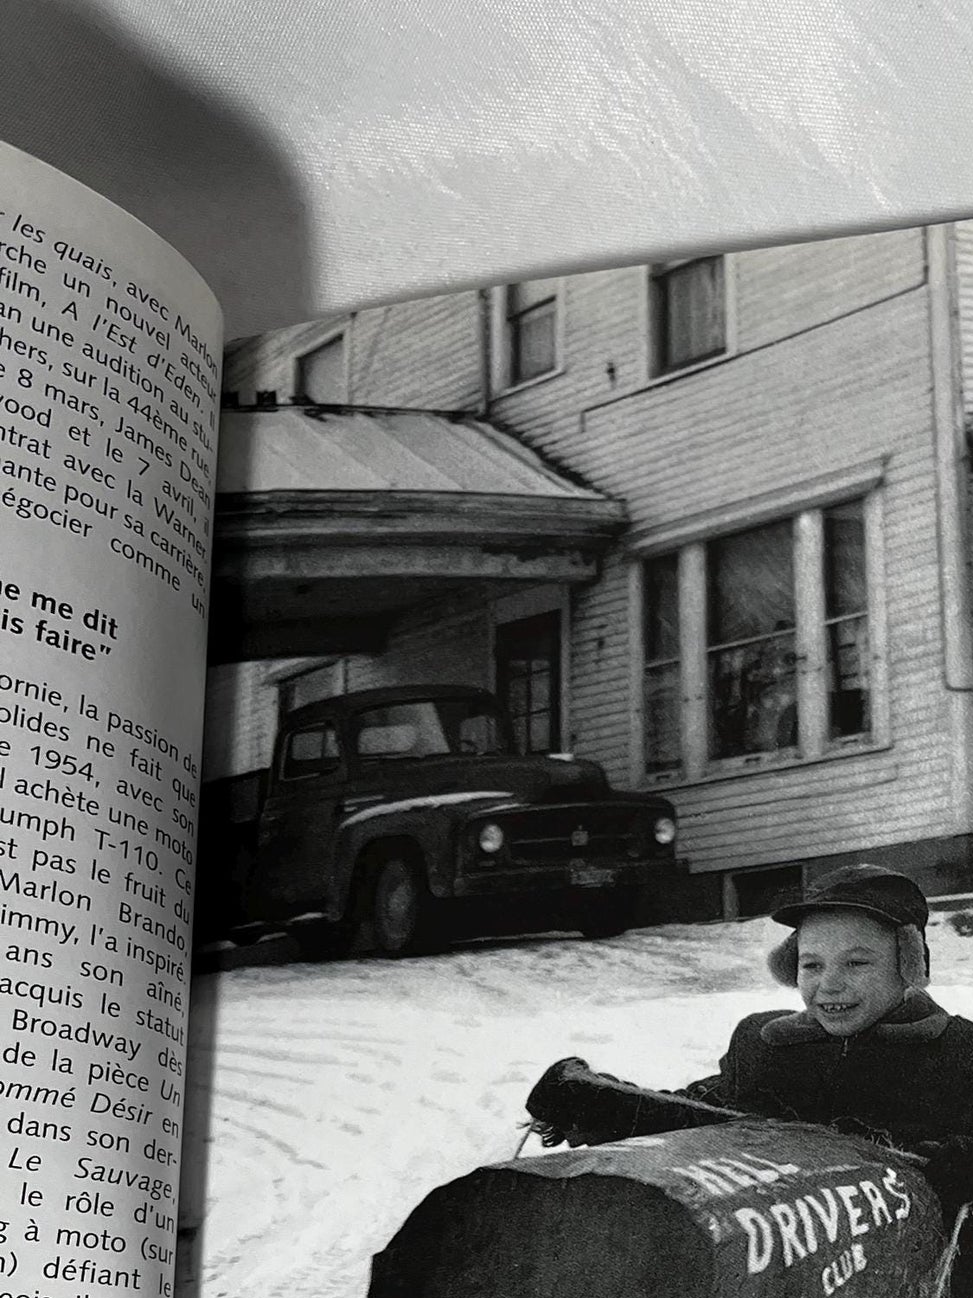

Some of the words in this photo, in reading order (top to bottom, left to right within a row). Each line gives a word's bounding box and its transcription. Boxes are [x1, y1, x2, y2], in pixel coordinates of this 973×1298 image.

[12, 215, 46, 244] les
[54, 242, 118, 287] quais,
[127, 282, 169, 320] avec
[175, 315, 218, 380] Marlon
[63, 273, 90, 298] un
[106, 297, 170, 349] nouvel
[0, 328, 54, 370] hers,
[63, 361, 97, 389] sur
[103, 378, 121, 405] la
[127, 396, 188, 454] 44ème
[32, 318, 74, 347] une
[82, 343, 164, 404] audition
[170, 398, 189, 424] au
[193, 419, 214, 454] stu-
[62, 302, 78, 322] A
[93, 314, 137, 354] l'Est
[148, 352, 204, 412] d'Eden.
[0, 393, 52, 430] ood
[68, 424, 91, 448] et
[106, 438, 123, 464] le
[138, 458, 150, 476] 7
[162, 480, 197, 522] avril,
[18, 368, 34, 389] 8
[45, 382, 106, 427] mars,
[115, 416, 172, 468] James
[180, 461, 210, 510] Dean
[63, 454, 117, 490] avec
[127, 480, 144, 506] la
[64, 484, 118, 520] pour
[124, 514, 145, 537] sa
[2, 488, 93, 538] égocier
[110, 538, 182, 592] comme
[191, 592, 206, 619] un
[2, 609, 24, 635] is
[31, 590, 74, 621] me
[83, 609, 118, 640] dit
[0, 674, 70, 714] ornie,
[79, 694, 100, 721] la
[106, 711, 179, 762] passion
[183, 753, 198, 780] de
[30, 746, 101, 788] 1954,
[116, 778, 164, 814] avec
[172, 808, 195, 838] son
[86, 735, 115, 758] ne
[130, 748, 162, 782] fait
[172, 776, 196, 808] que
[0, 807, 76, 842] umph
[94, 828, 163, 875] T-110.
[175, 868, 192, 896] Ce
[14, 779, 100, 816] achète
[108, 806, 149, 836] une
[156, 828, 194, 866] moto
[32, 849, 76, 875] pas
[91, 859, 111, 885] le
[124, 872, 167, 909] fruit
[174, 900, 190, 925] du
[1, 903, 80, 946] immy,
[91, 924, 118, 953] l'a
[6, 944, 53, 969] ans
[80, 961, 124, 987] son
[0, 977, 83, 1009] acquis
[100, 993, 120, 1018] le
[136, 1008, 184, 1047] statut
[12, 1008, 142, 1062] Broadway
[158, 1047, 183, 1078] dès
[3, 1041, 37, 1068] de
[52, 1048, 73, 1074] la
[88, 1060, 150, 1092] pièce
[160, 1080, 180, 1107] Un
[7, 1111, 72, 1142] dans
[86, 1130, 130, 1154] son
[143, 1140, 178, 1167] der-
[90, 1092, 153, 1126] Désir
[162, 1117, 180, 1139] en
[8, 1147, 42, 1172] Le
[74, 1157, 176, 1204] Sauvage,
[20, 1182, 44, 1207] le
[65, 1190, 115, 1217] rôle
[134, 1202, 175, 1234] d'un
[24, 1219, 40, 1243] à
[56, 1228, 126, 1254] moto
[140, 1236, 174, 1266] (sur
[735, 1168, 911, 1273] DRIVERS
[43, 1256, 142, 1290] défiant
[158, 1274, 172, 1298] le
[822, 1243, 867, 1296] CLUB
